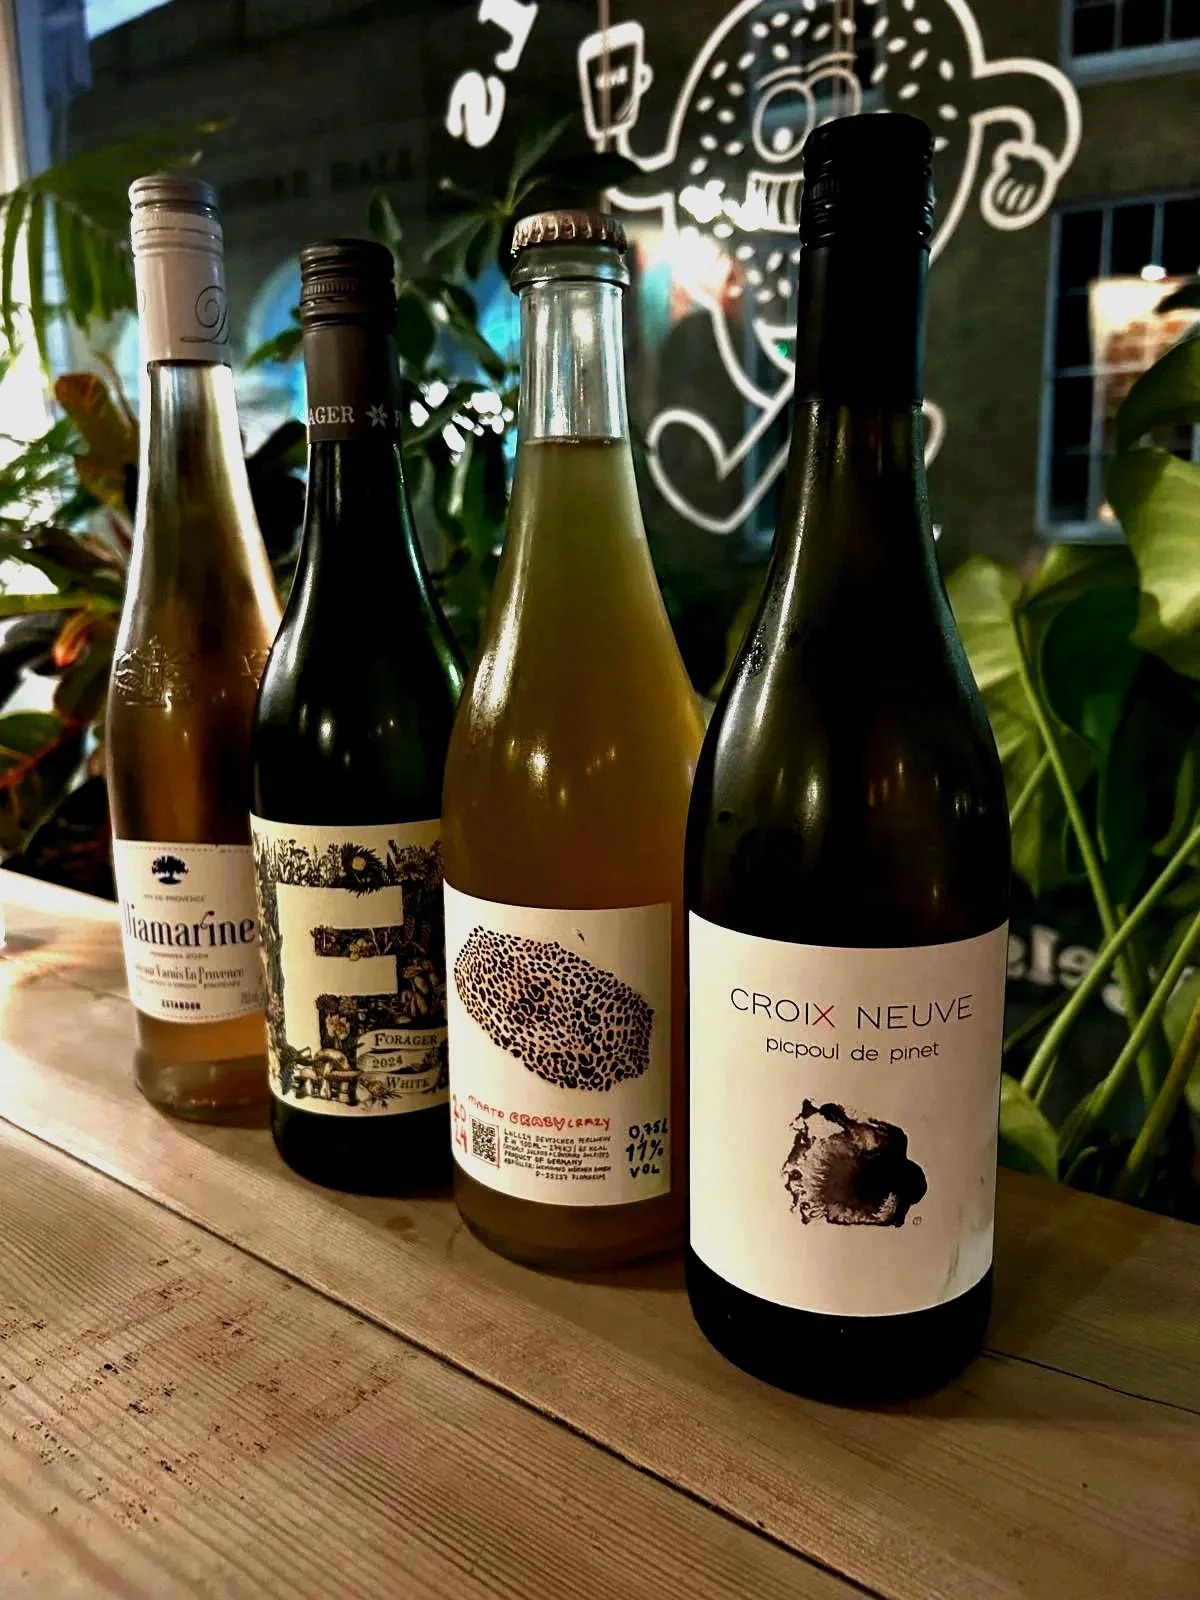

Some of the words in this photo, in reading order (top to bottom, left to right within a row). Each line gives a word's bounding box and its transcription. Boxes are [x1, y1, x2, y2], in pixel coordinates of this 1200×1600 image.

[309, 406, 355, 425] AGER
[730, 988, 836, 1028] CROIX
[857, 994, 973, 1029] NEUVE
[766, 1037, 839, 1060] picpoul
[850, 1045, 879, 1062] de
[890, 1042, 940, 1064] pinet
[372, 1056, 402, 1068] 2024
[628, 1117, 668, 1143] 0,75L
[504, 1150, 532, 1161] PRODUCT
[547, 1158, 583, 1167] GERMANY
[626, 1139, 664, 1162] 11%
[629, 1163, 660, 1179] VOL
